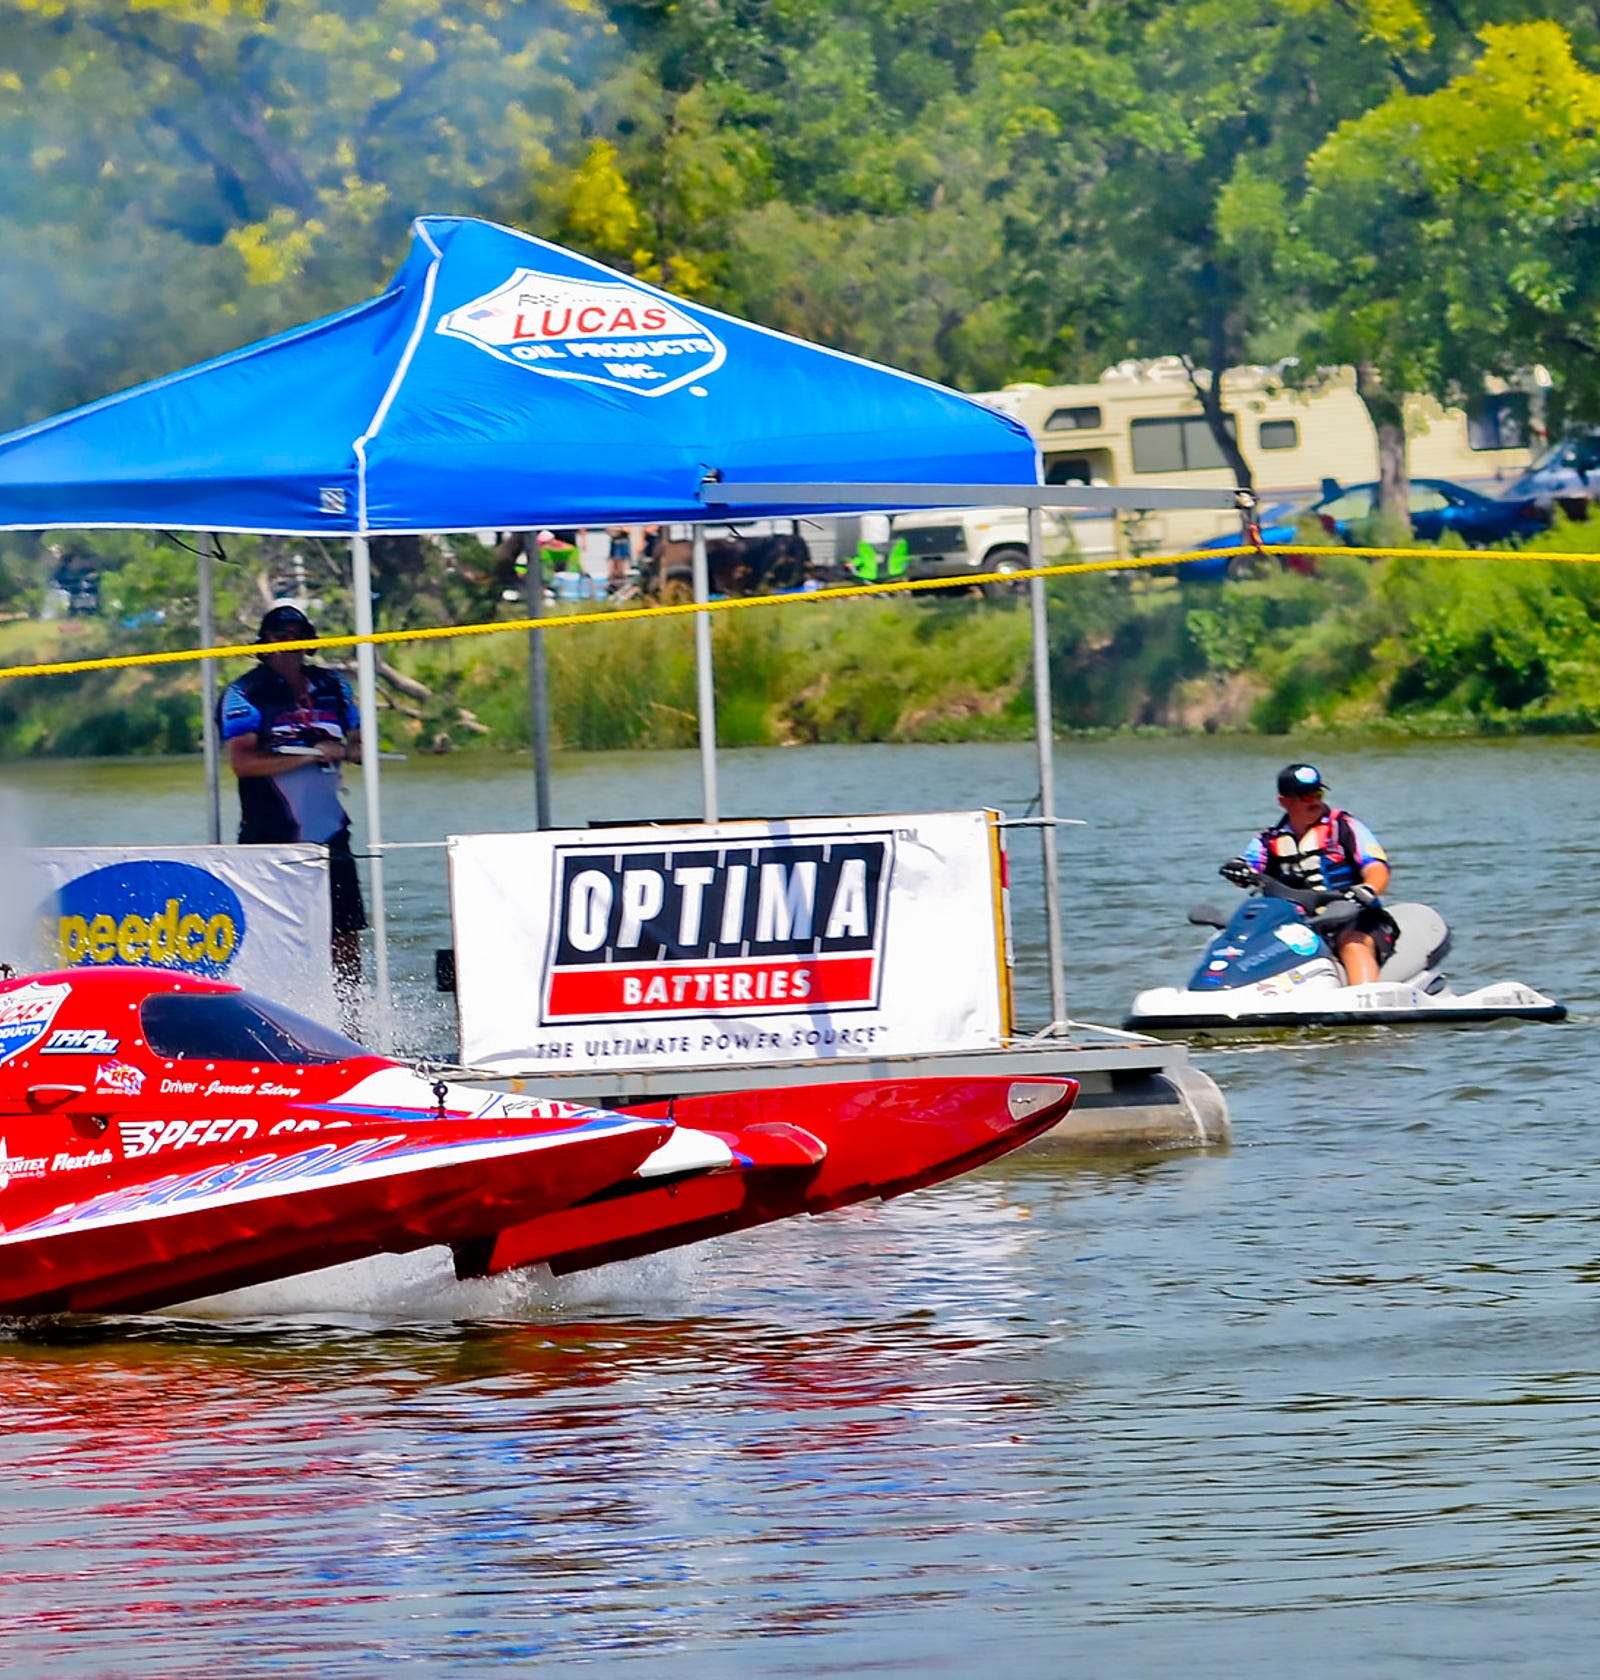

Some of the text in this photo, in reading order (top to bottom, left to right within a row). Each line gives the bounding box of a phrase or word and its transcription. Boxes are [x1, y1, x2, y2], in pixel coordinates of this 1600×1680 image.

[512, 307, 667, 339] LUCAS
[510, 338, 715, 361] OIL PRODUCTS
[603, 363, 667, 380] INC.
[567, 858, 869, 952] OPTIMA
[623, 968, 811, 1005] BATTERIES
[535, 1042, 574, 1059] THE
[585, 1036, 691, 1057] ULTIMATE
[701, 1032, 781, 1051] POWER
[160, 1078, 198, 1094] Driver
[51, 1148, 113, 1171] Flexfab
